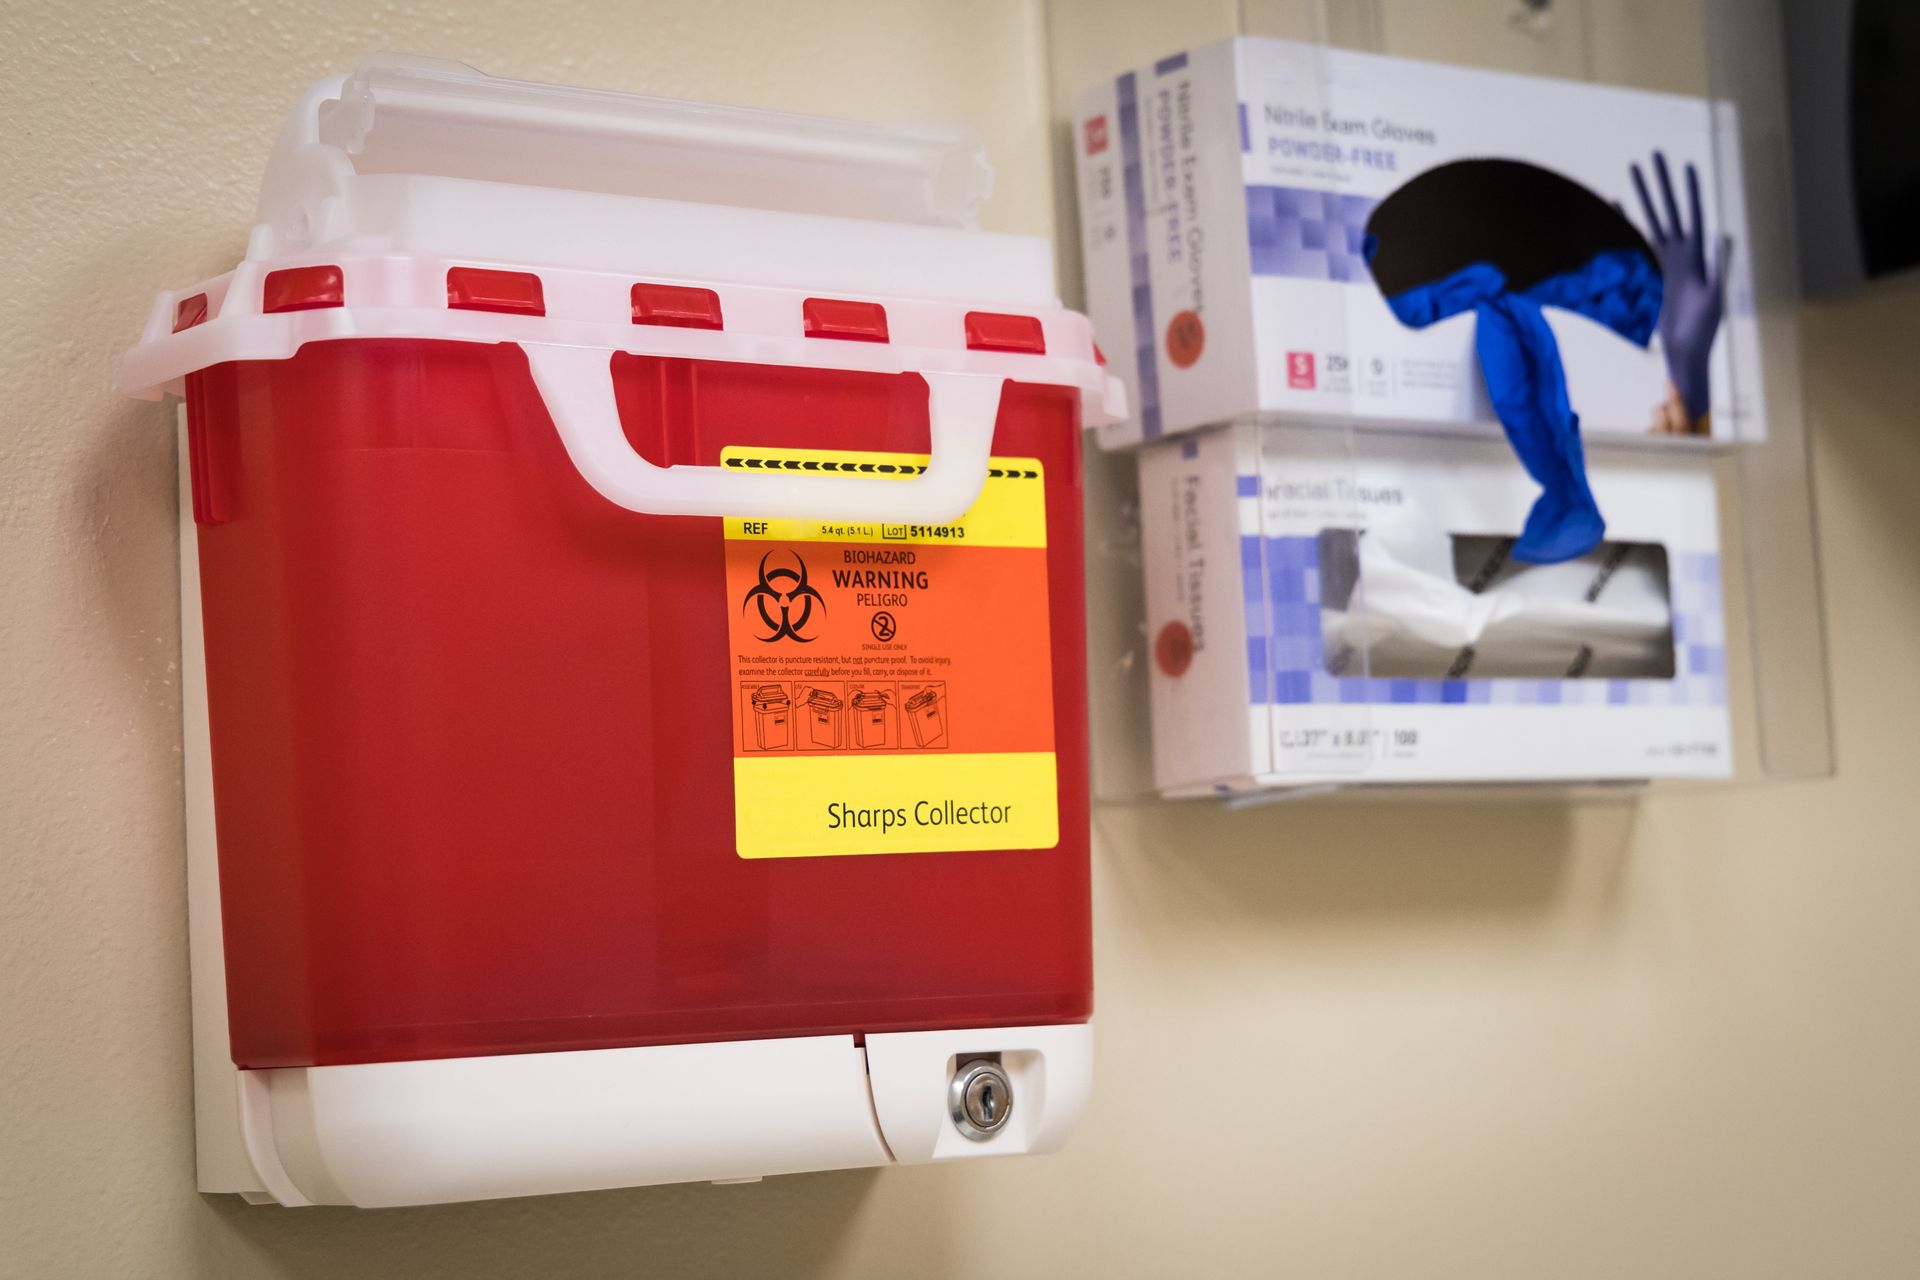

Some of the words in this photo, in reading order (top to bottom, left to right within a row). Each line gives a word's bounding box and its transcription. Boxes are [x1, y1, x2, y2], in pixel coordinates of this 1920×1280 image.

[743, 522, 769, 535] REF
[821, 526, 834, 534] 5.4
[835, 527, 846, 536] qt.
[847, 526, 862, 536] (5.1
[863, 527, 874, 537] L.)
[887, 528, 904, 536] LOT
[910, 525, 966, 538] 5114913
[843, 550, 917, 565] BIOHAZARD
[832, 569, 929, 590] WARNING
[856, 593, 909, 608] PELIGRO
[862, 643, 881, 651] SINGLE
[738, 655, 751, 664] This
[752, 655, 778, 664] collector
[779, 656, 785, 664] is
[785, 656, 812, 665] puncture
[813, 656, 840, 665] resistant,
[841, 656, 852, 664] but
[852, 657, 863, 665] not
[864, 656, 890, 665] puncture
[890, 655, 907, 665] proof.
[910, 655, 917, 664] To
[917, 656, 934, 664] avoid
[738, 668, 765, 676] examine
[765, 667, 777, 676] the
[777, 667, 803, 676] collector
[804, 667, 830, 677] carefully
[831, 667, 851, 676] before
[851, 668, 863, 677] you
[863, 667, 872, 676] fill,
[872, 668, 888, 677] carry,
[896, 667, 918, 677] dispose
[919, 667, 926, 676] of
[1394, 730, 1417, 746] 100
[828, 802, 907, 834] Sharps
[914, 800, 1011, 826] Collector
